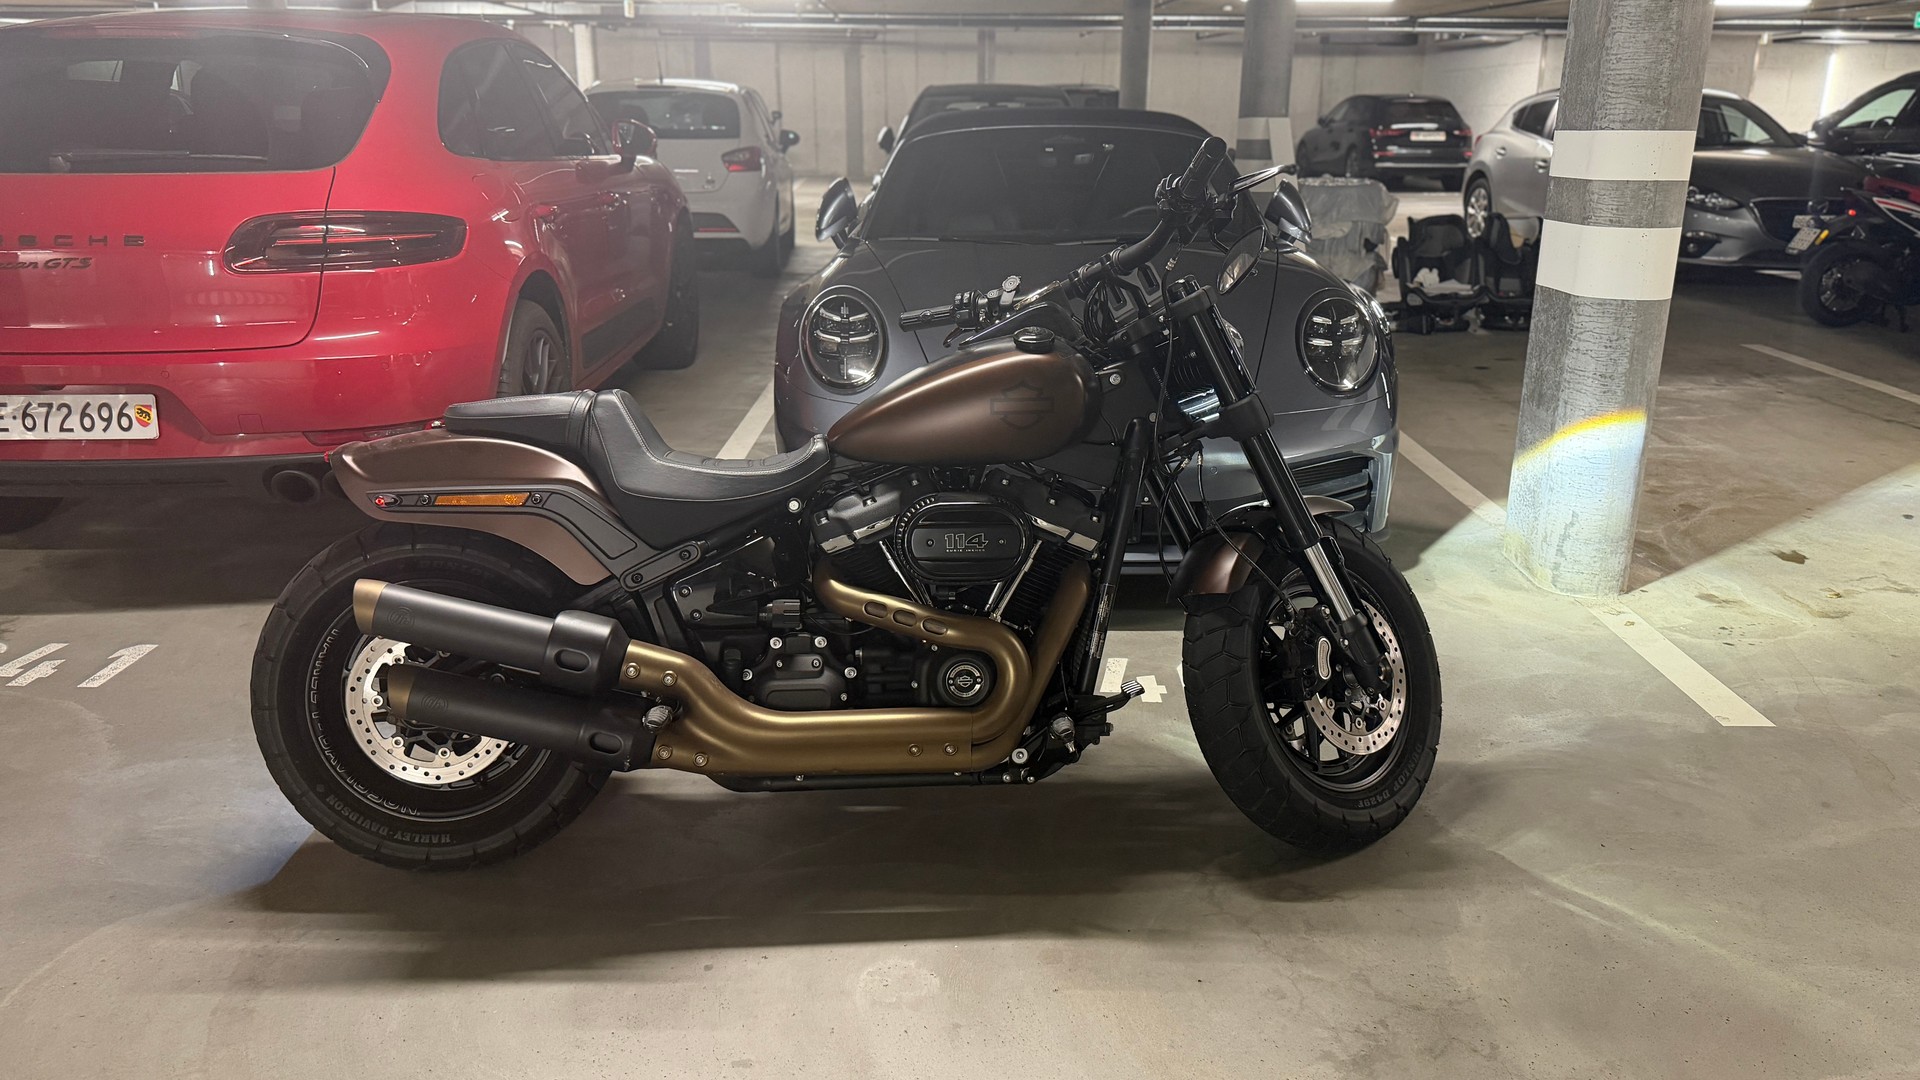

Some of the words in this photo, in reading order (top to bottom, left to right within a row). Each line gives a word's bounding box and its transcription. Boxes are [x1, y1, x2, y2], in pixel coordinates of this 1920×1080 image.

[0, 234, 144, 247] SCHE
[43, 257, 93, 270] GTS
[944, 532, 989, 549] 114
[0, 642, 160, 688] 41
[1393, 743, 1423, 792] DUNLOP
[325, 793, 451, 844] HARLEY-DAVIDSON
